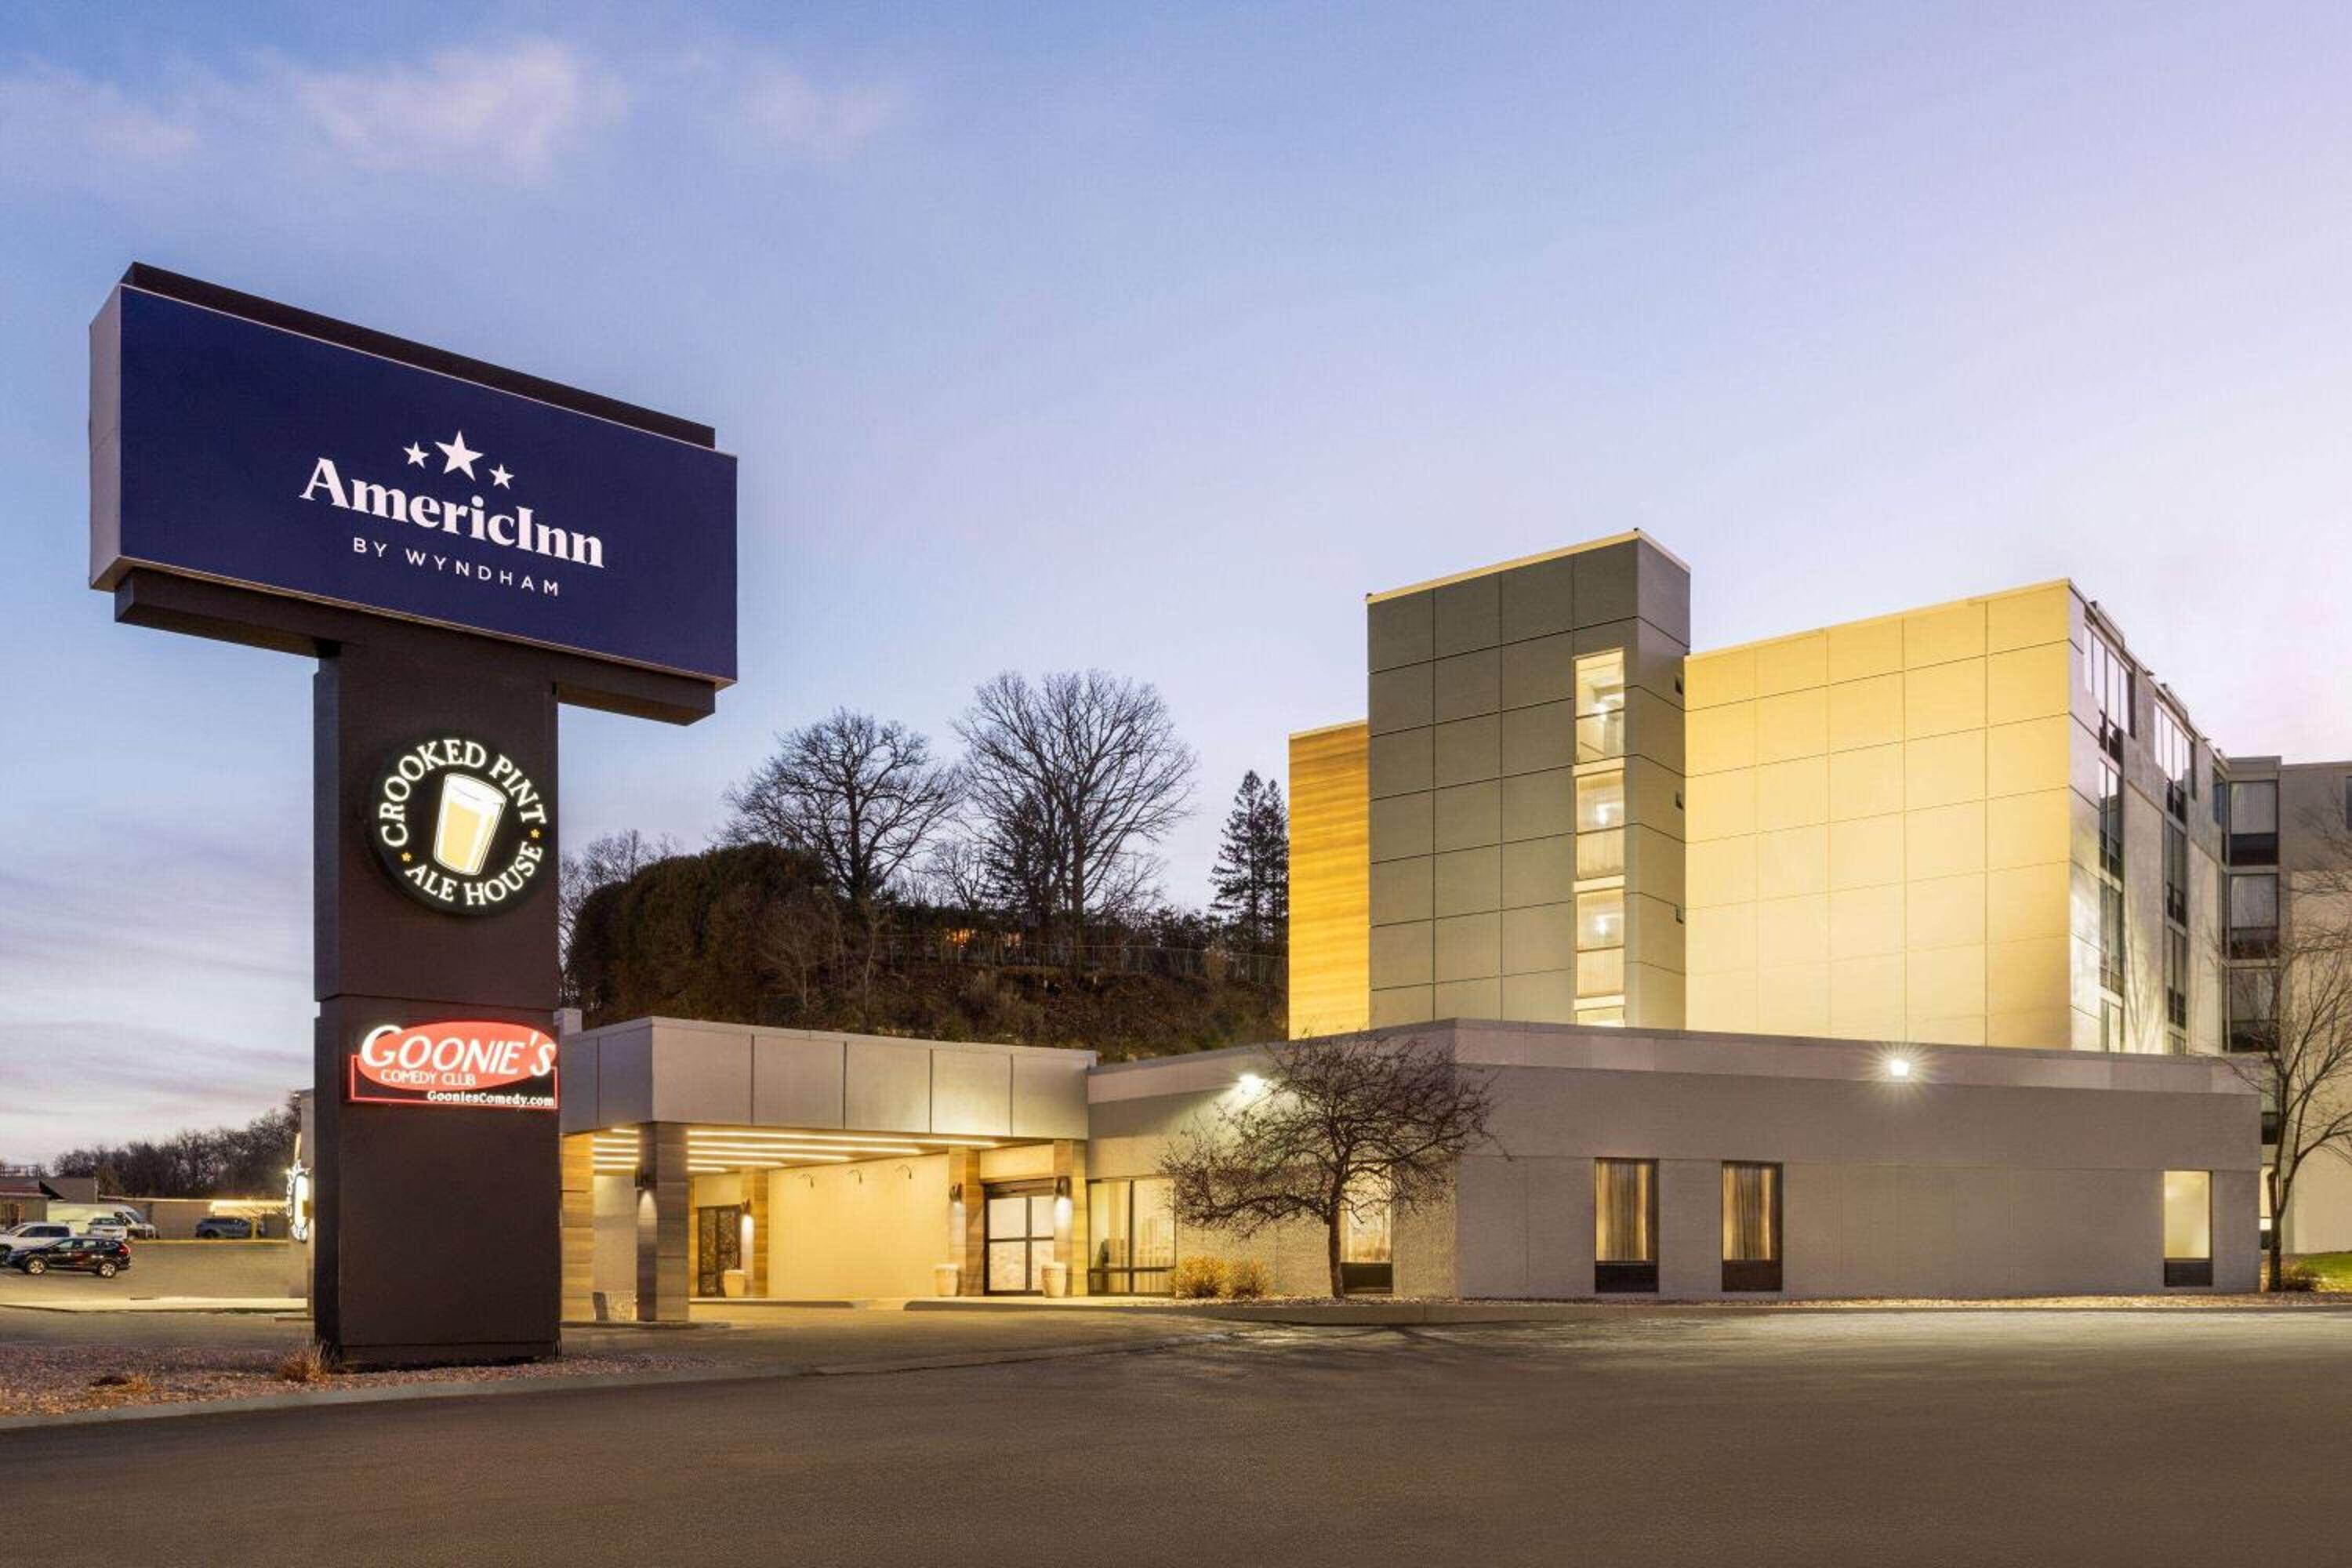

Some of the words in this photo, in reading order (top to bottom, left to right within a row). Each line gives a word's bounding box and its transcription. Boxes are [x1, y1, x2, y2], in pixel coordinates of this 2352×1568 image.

[299, 457, 604, 568] AmericInn
[354, 538, 387, 557] BY
[405, 549, 559, 597] WYNDHAM
[379, 739, 487, 848] CROOKED
[489, 755, 546, 824] PINT
[405, 864, 457, 902] ALE
[463, 841, 543, 905] HOUSE
[361, 1025, 557, 1076] GOONIE'S
[380, 1069, 437, 1085] COMEDY
[442, 1072, 476, 1087] CLUB
[427, 1091, 554, 1107] GooniesComedy.com
